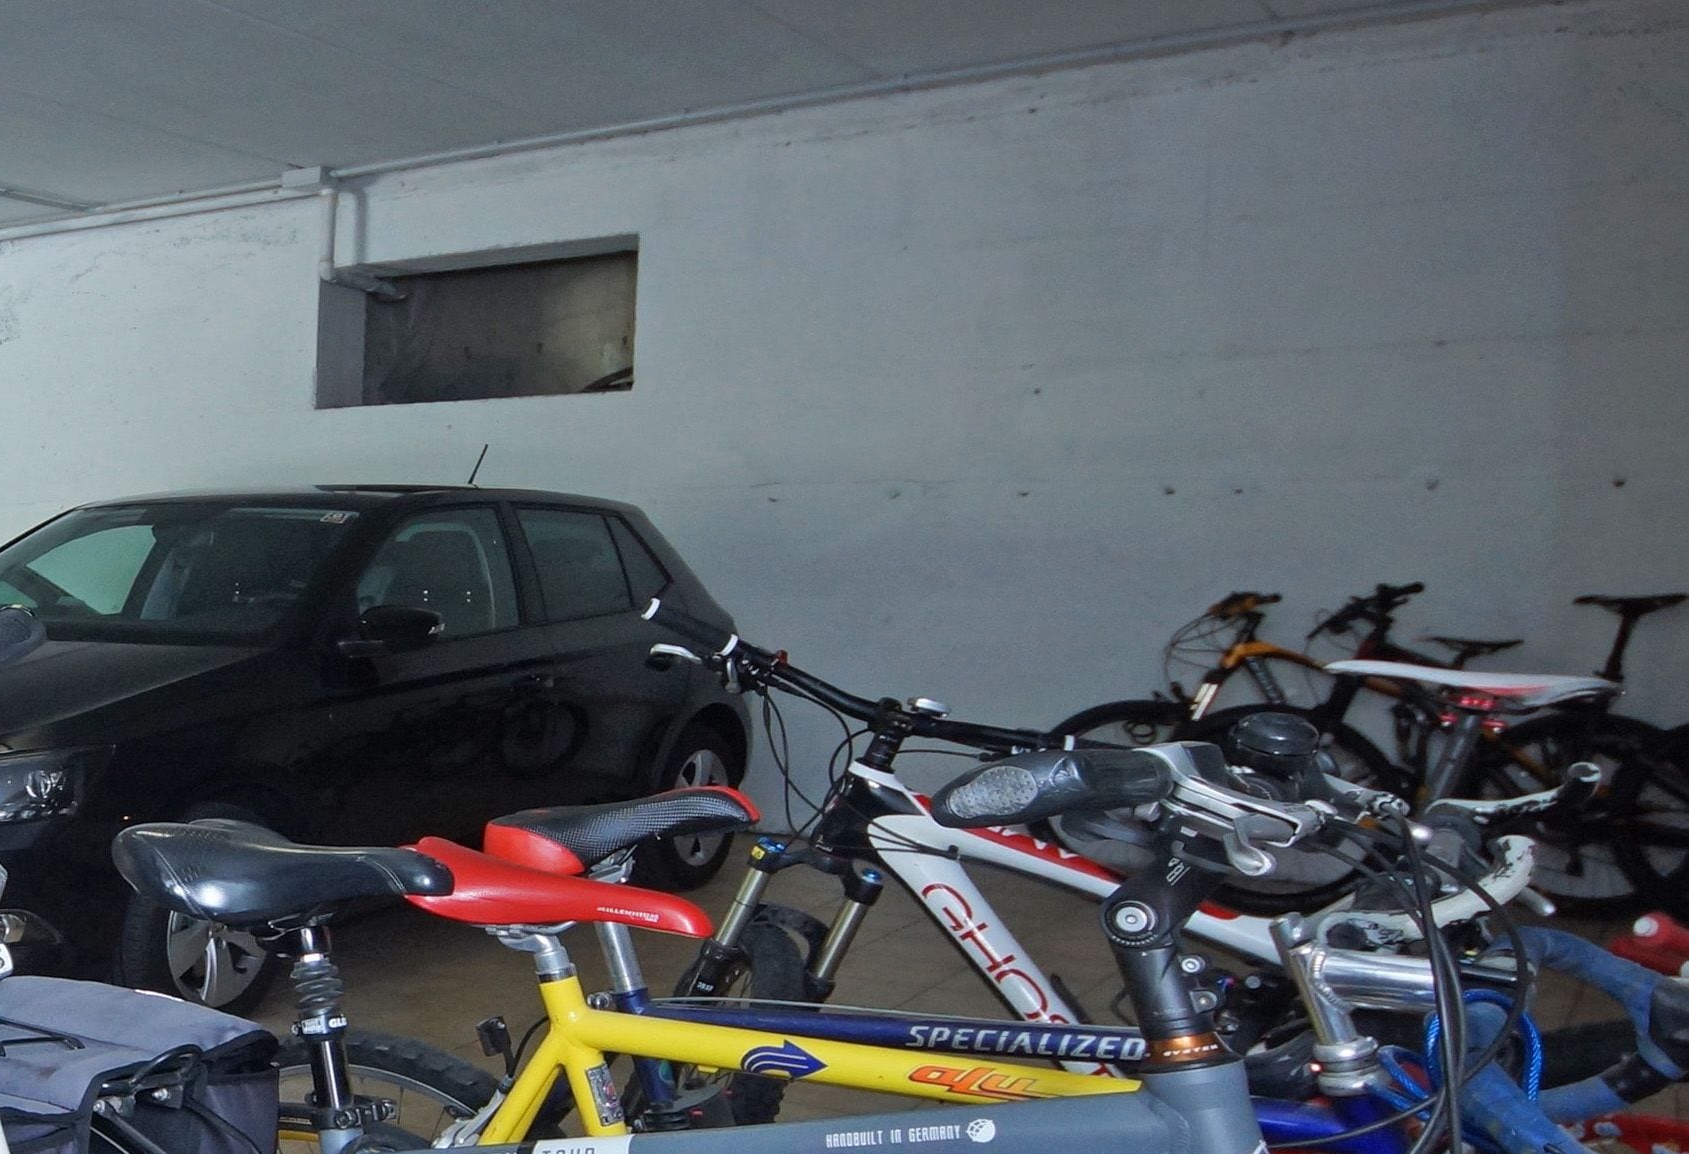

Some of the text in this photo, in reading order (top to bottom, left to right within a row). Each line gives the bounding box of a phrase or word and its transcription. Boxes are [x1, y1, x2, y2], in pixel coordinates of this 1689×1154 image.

[906, 1025, 1147, 1060] SPECIALIZED
[826, 1125, 961, 1148] HANDBUILT IN GERMANY
